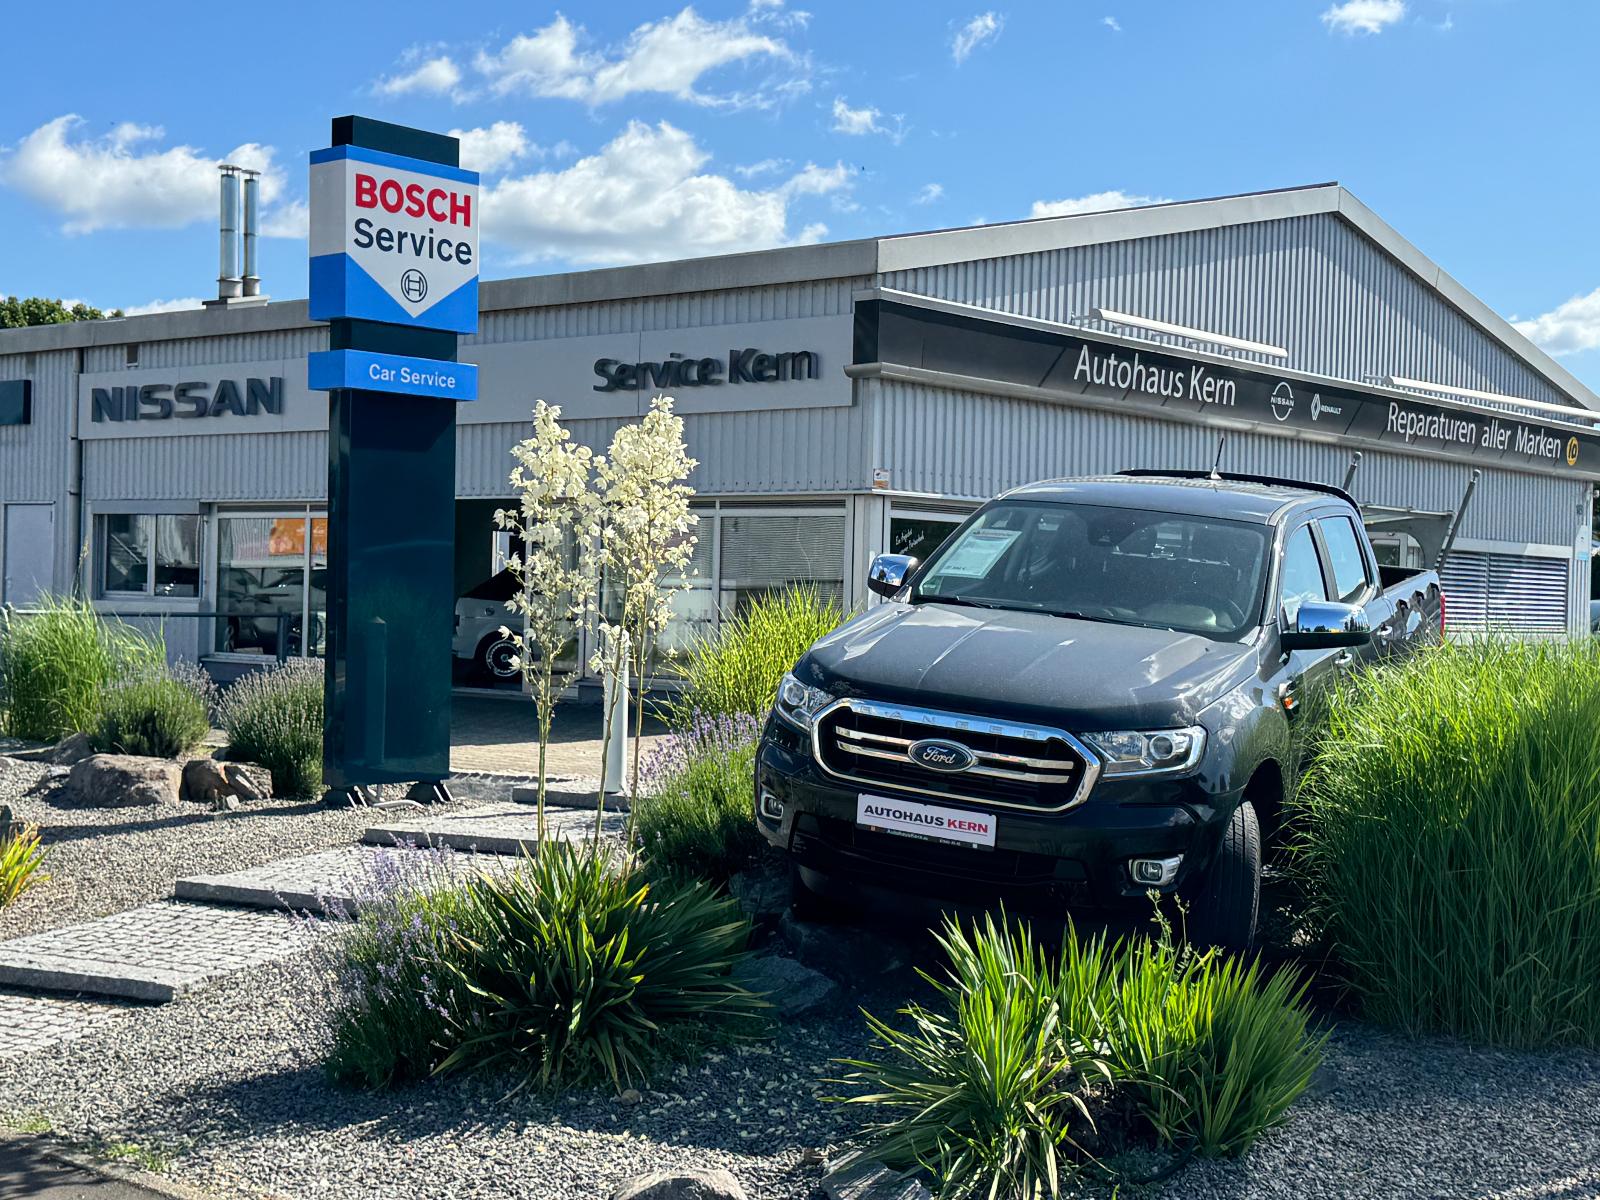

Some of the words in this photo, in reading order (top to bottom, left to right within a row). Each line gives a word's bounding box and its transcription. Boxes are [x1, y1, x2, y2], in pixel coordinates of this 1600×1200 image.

[355, 173, 471, 228] BOSCH
[353, 218, 472, 266] Service
[369, 363, 395, 382] Car
[400, 366, 456, 388] Service
[593, 352, 723, 393] Service
[729, 348, 820, 384] Kern
[1074, 344, 1184, 399] Autohaus
[1189, 365, 1236, 406] Kern
[91, 376, 282, 423] NISSAN
[1270, 396, 1295, 407] NISSAN
[1320, 404, 1342, 415] RENAULT
[1387, 402, 1476, 444] Reparaturen
[1481, 419, 1511, 450] aller
[1514, 425, 1562, 459] Marken
[922, 746, 957, 764] Ford
[863, 804, 944, 827] AUTOHAUS
[947, 818, 989, 834] KERN
